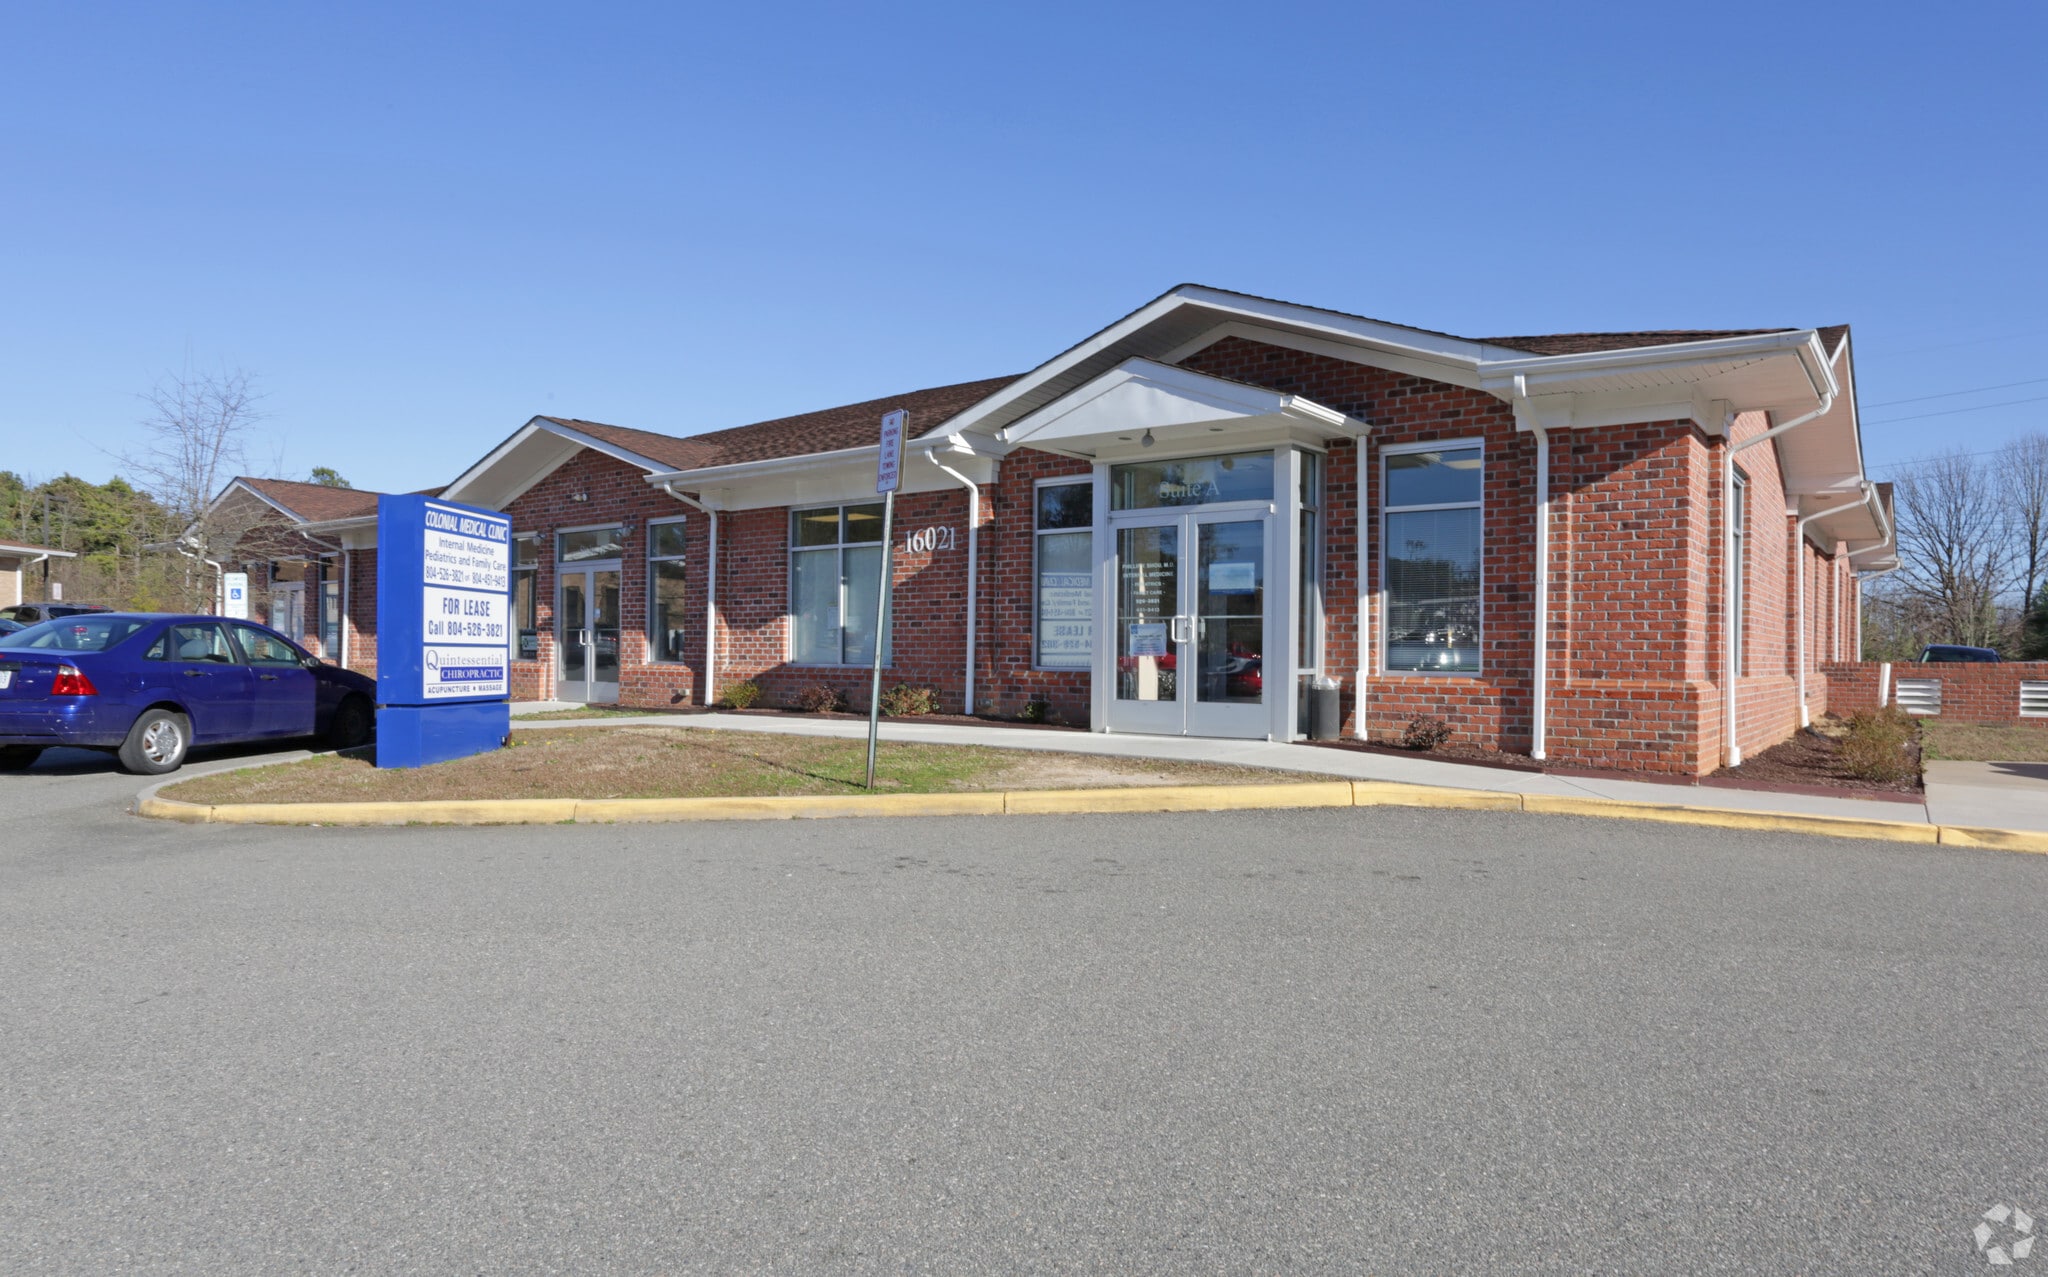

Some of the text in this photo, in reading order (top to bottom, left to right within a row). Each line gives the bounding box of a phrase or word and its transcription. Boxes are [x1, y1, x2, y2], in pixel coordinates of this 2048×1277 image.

[1159, 479, 1220, 498] Suite A
[425, 510, 508, 541] COLONIAL MEDICAL CLINIC
[439, 536, 494, 556] Internal Medicine
[904, 525, 956, 553] 16021
[425, 549, 506, 571] Pediatrics and Family Care
[425, 565, 464, 582] 804-526-3821
[443, 597, 490, 617] FOR LEASE
[428, 620, 503, 637] Call 804-526-3821
[425, 649, 502, 671] Quintessential
[441, 669, 503, 679] CHIROPRACTIC
[428, 685, 470, 694] ACUPUNCTURE
